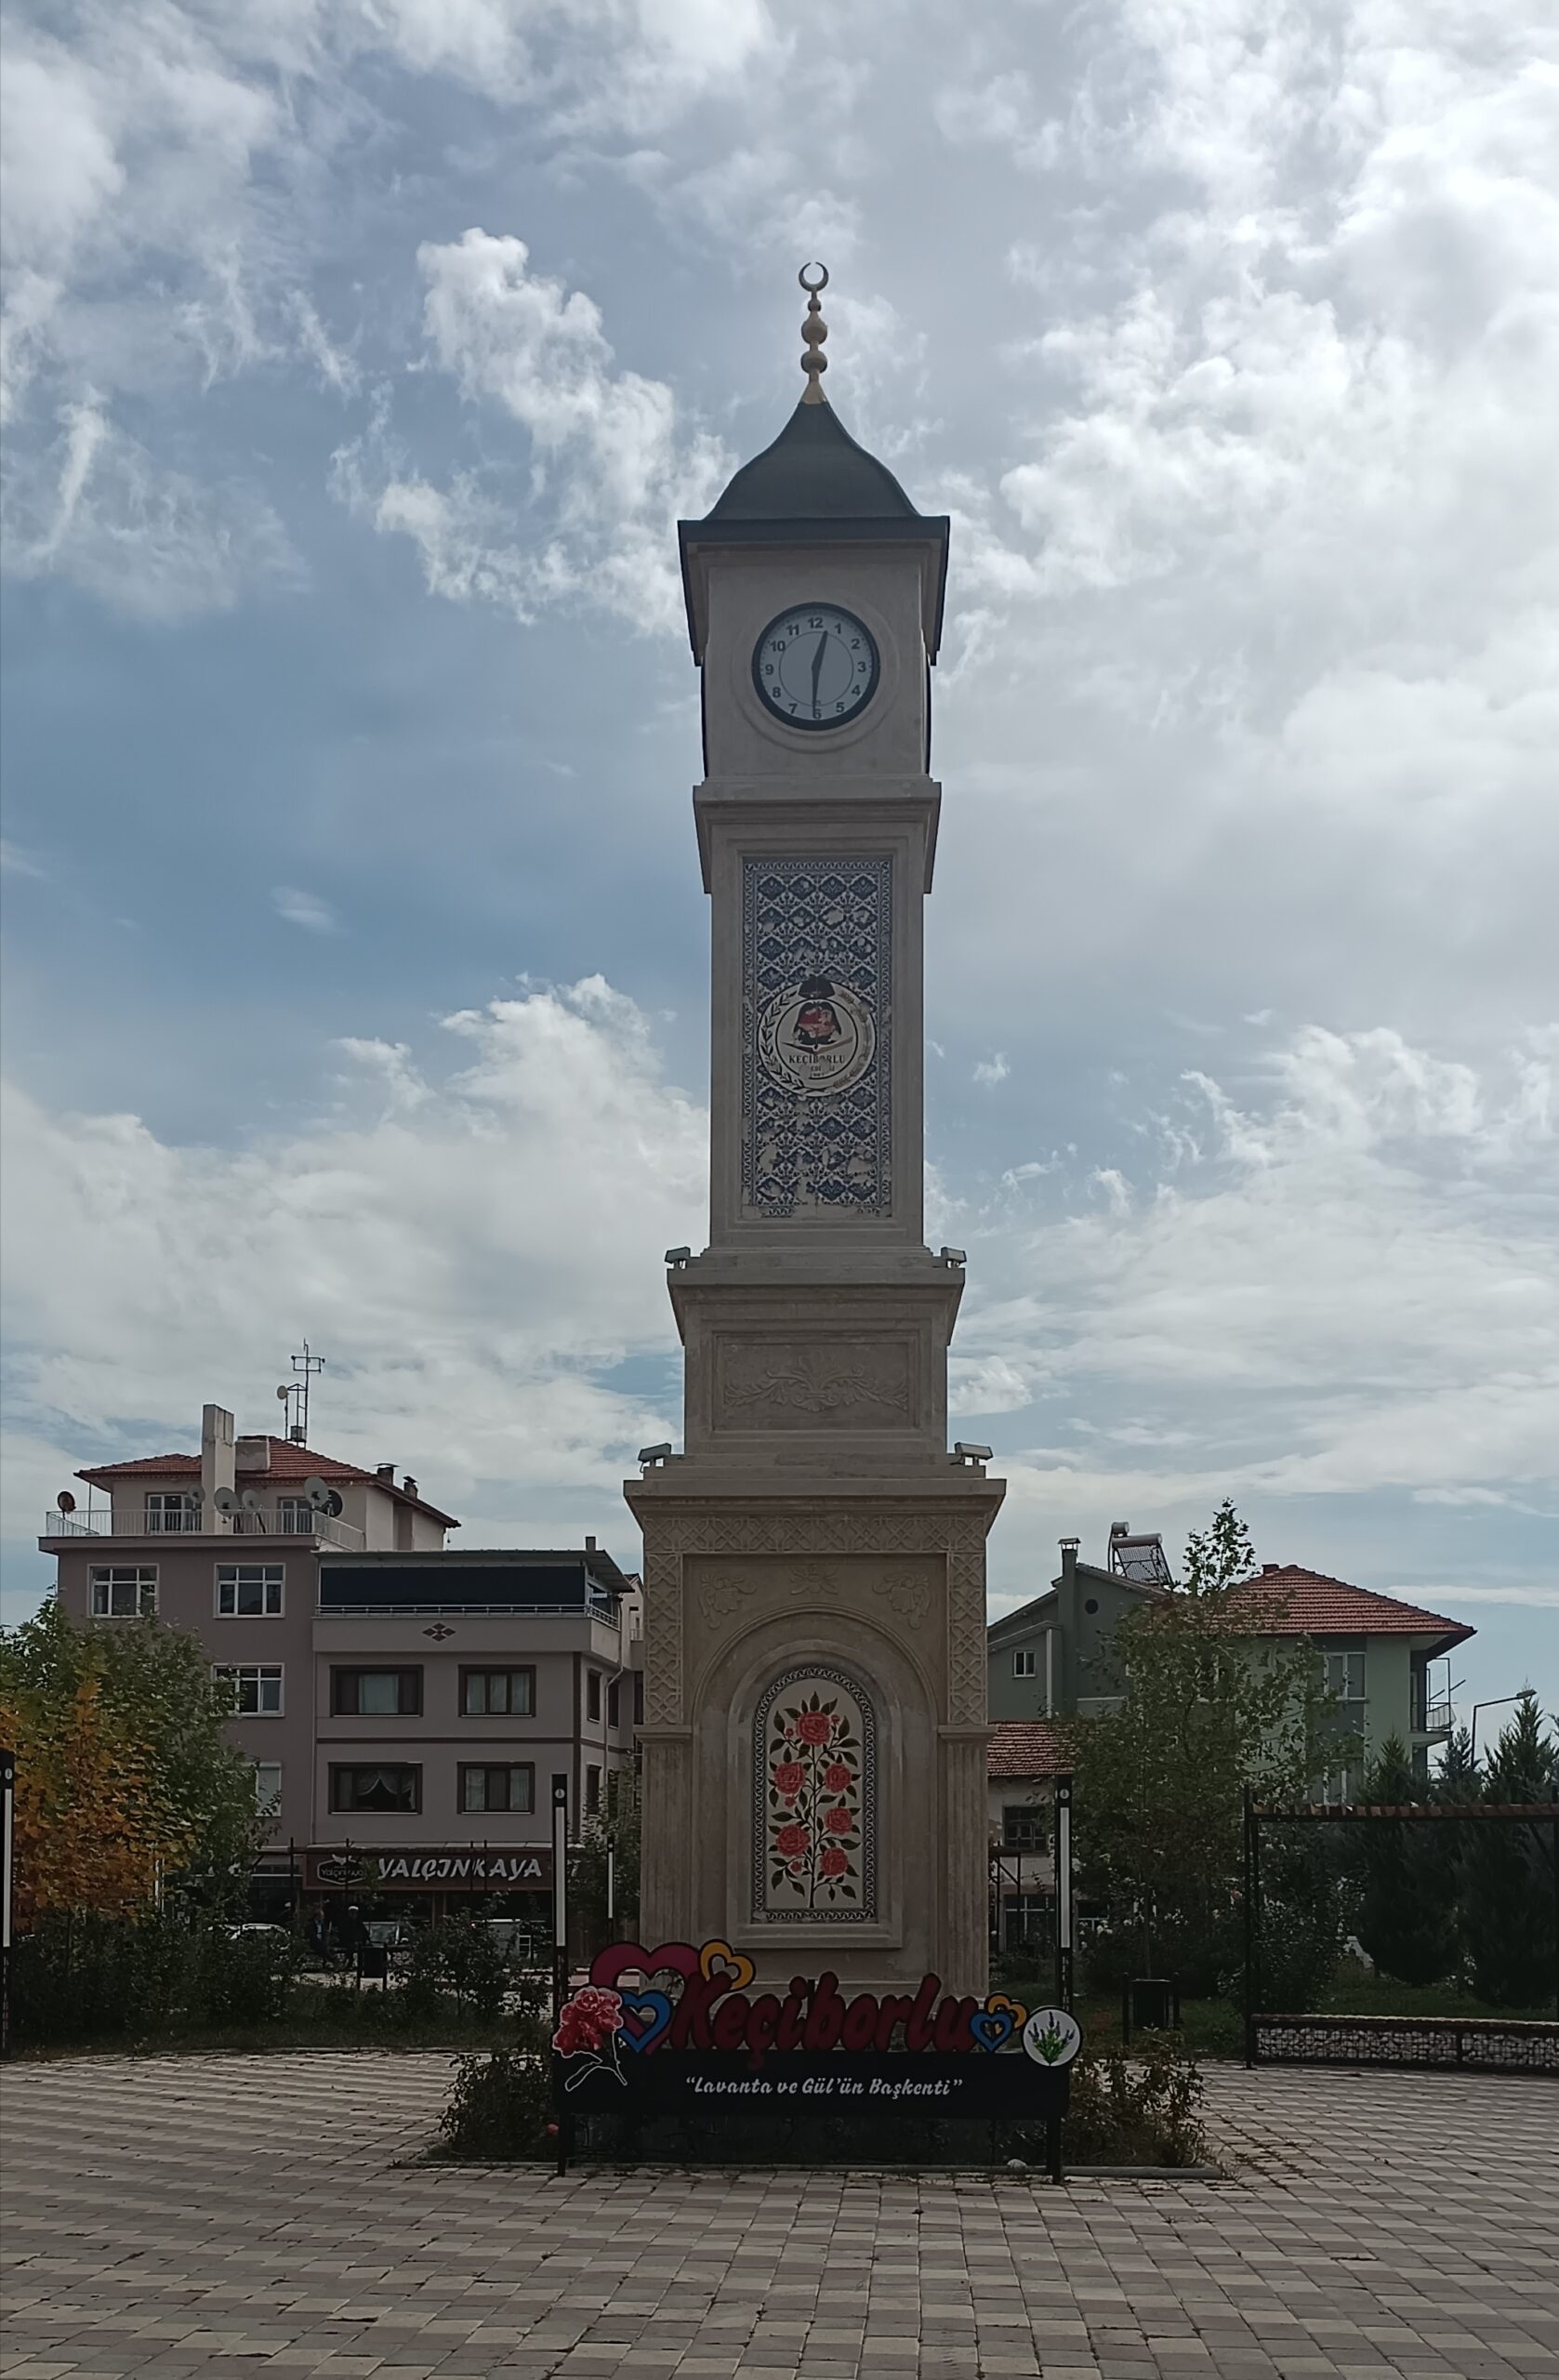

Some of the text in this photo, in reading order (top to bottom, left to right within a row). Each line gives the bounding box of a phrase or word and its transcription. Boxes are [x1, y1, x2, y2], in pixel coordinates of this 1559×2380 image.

[807, 617, 824, 628] 12
[786, 625, 799, 636] 11
[835, 624, 842, 634] 1
[770, 641, 786, 652] 10
[851, 639, 860, 650] 2
[765, 664, 774, 675] 9
[857, 661, 866, 672] 3
[772, 686, 782, 698] 8
[851, 684, 861, 695] 4
[787, 703, 798, 714] 7
[836, 702, 845, 713] 5
[813, 708, 822, 720] 6
[669, 1970, 980, 2071] Keçiborlu
[685, 2076, 964, 2099] “Lavanta ve Gül’ün Başkenti”
